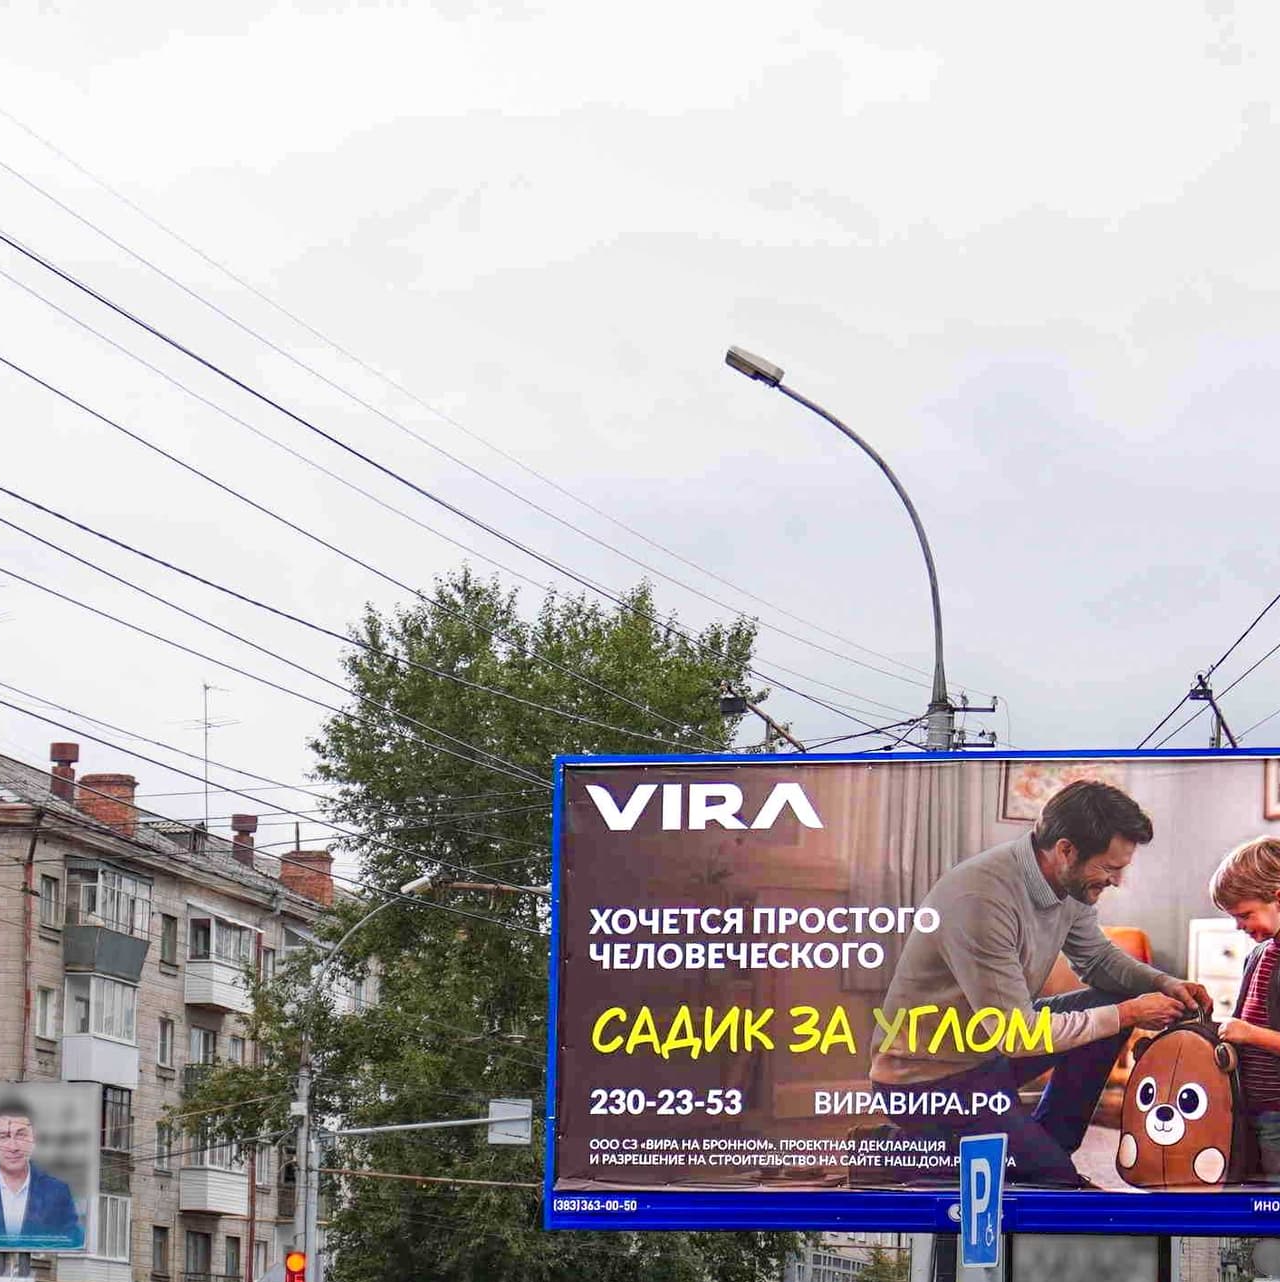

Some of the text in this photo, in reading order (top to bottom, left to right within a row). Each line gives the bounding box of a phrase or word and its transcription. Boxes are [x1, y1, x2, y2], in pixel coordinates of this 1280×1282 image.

[586, 783, 823, 830] VIRA
[589, 906, 941, 934] ХОЧЕТСЯ ПРОСТОГО
[589, 942, 885, 969] ЧЕЛОВЕЧЕСКОГО
[592, 1006, 1056, 1059] САДИК ЗА УГЛОМ
[590, 1089, 742, 1115] 230-23-53
[814, 1089, 1011, 1117] ВИРАВИРА.РФ
[589, 1139, 946, 1153] ООО СЗ «ВИРА НА БРОННОМ». ПРОЕКТНАЯ ДЕКЛАРАЦИЯ
[589, 1153, 961, 1168] И РАЗРЕШЕНИЕ НА СТРОИТЕЛЬСТВО НА САЙТЕ НАШ.ДОМ.Р
[553, 1200, 637, 1212] (383)363-00-50
[971, 1158, 991, 1245] P
